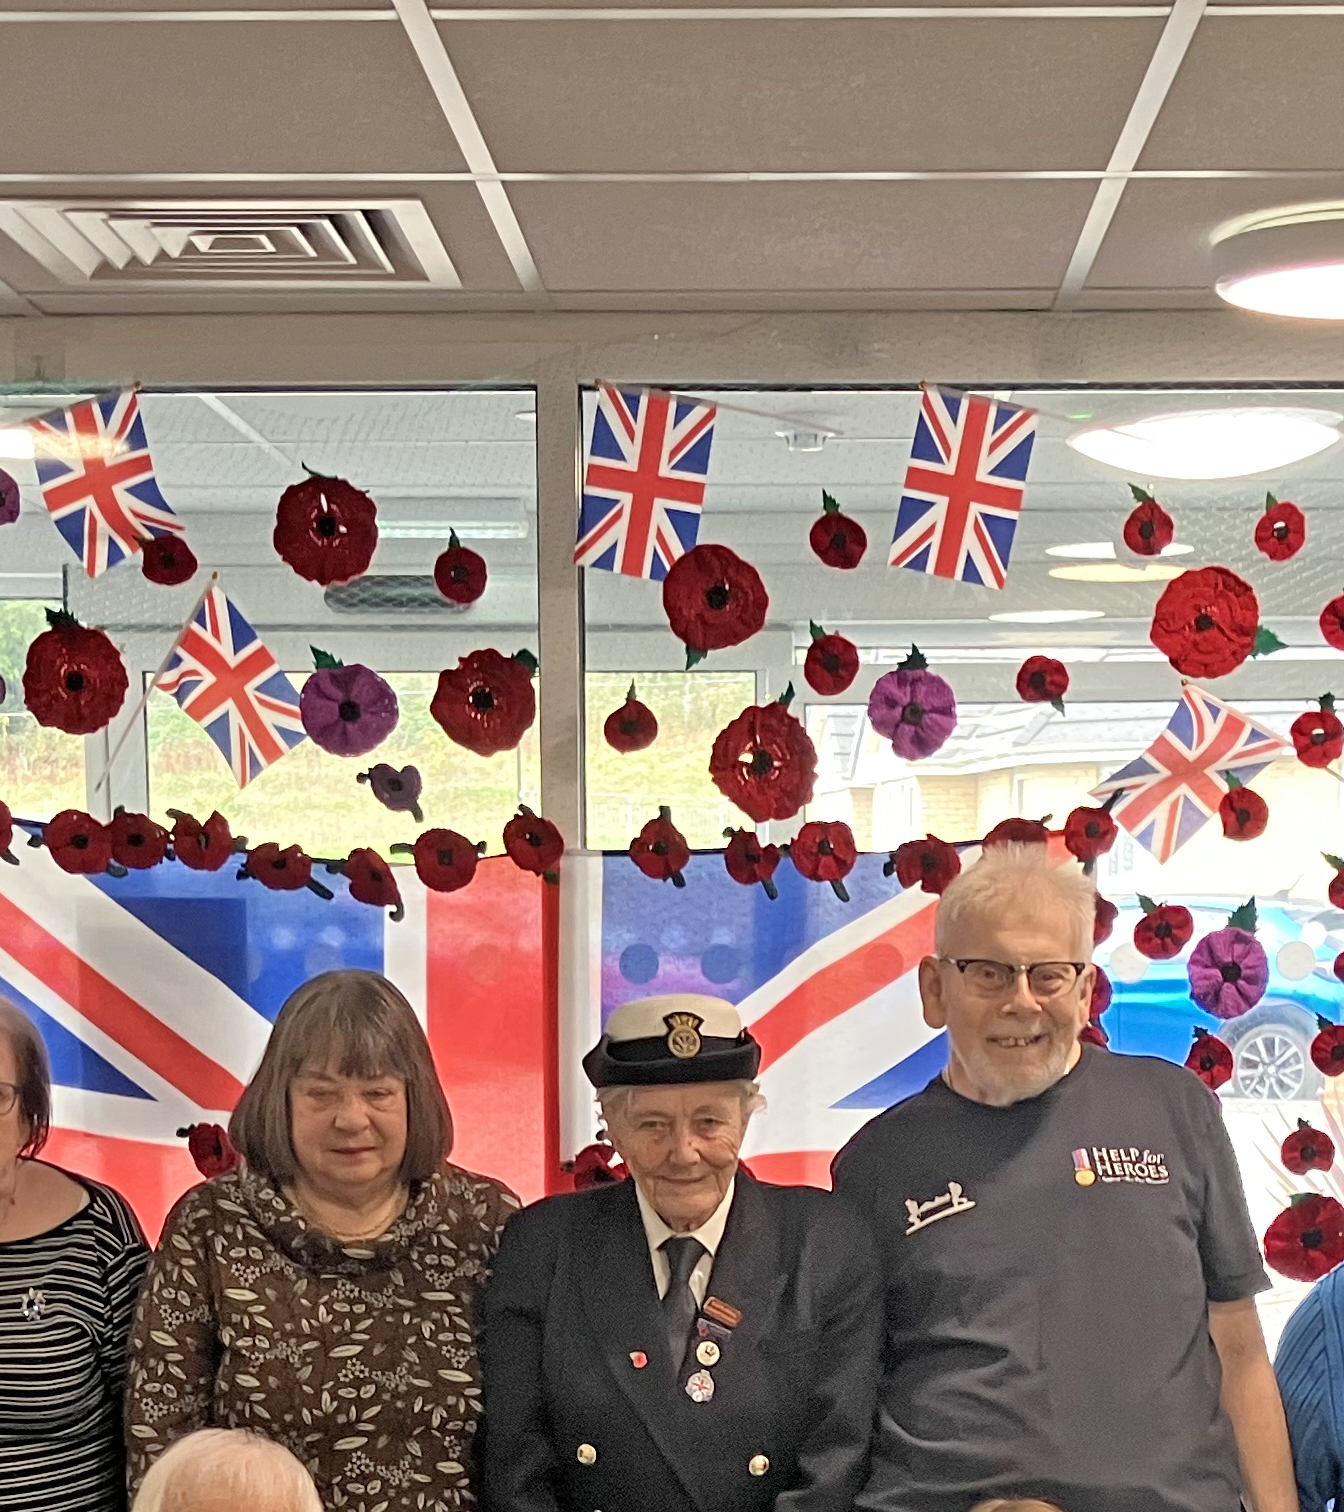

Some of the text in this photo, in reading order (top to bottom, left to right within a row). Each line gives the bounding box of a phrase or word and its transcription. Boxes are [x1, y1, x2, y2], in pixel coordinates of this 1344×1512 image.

[1092, 1147, 1165, 1165] HELP for
[1096, 1161, 1169, 1178] HEROES
